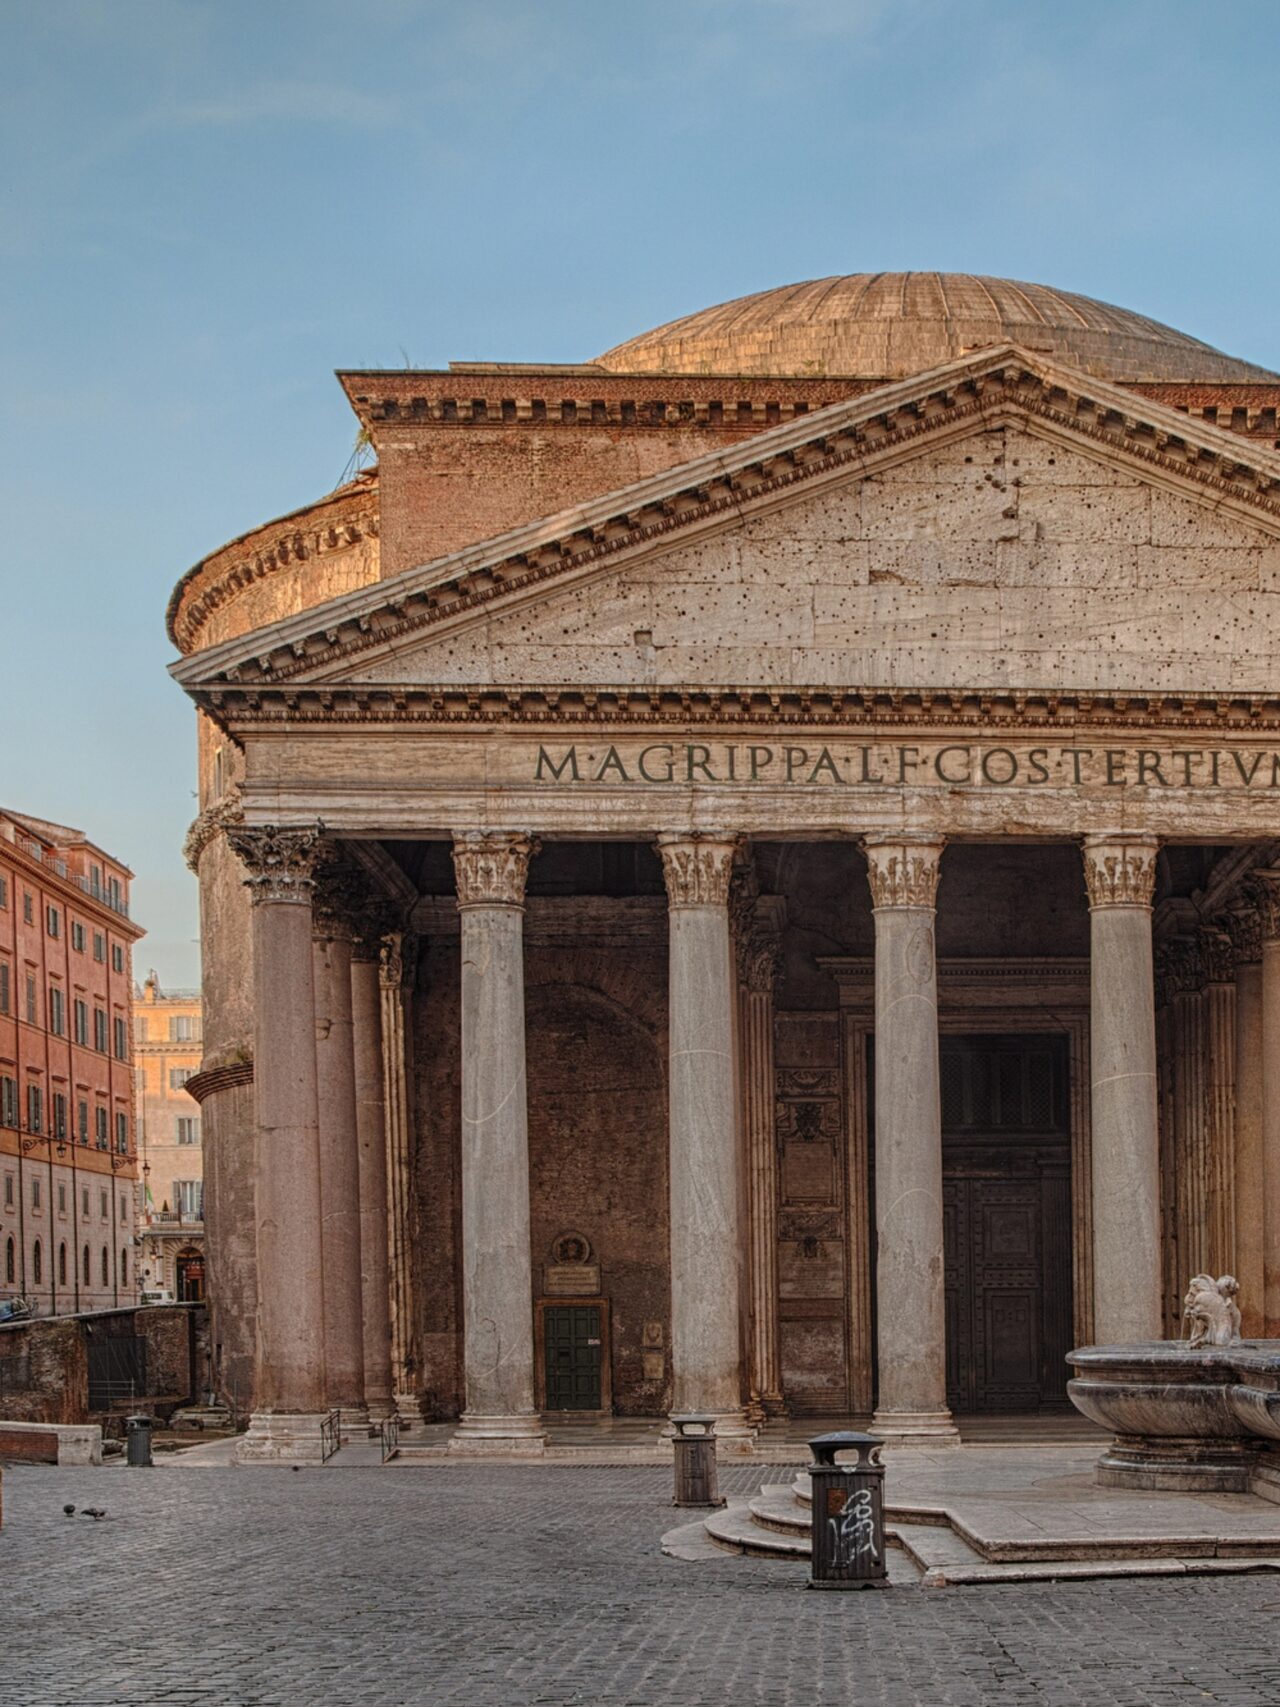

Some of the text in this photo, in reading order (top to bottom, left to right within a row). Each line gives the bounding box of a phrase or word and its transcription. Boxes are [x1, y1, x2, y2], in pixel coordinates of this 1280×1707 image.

[533, 744, 584, 782] M
[590, 744, 848, 784] AGRIPPA
[857, 745, 884, 784] L
[897, 746, 920, 784] F
[933, 745, 1050, 785] COS
